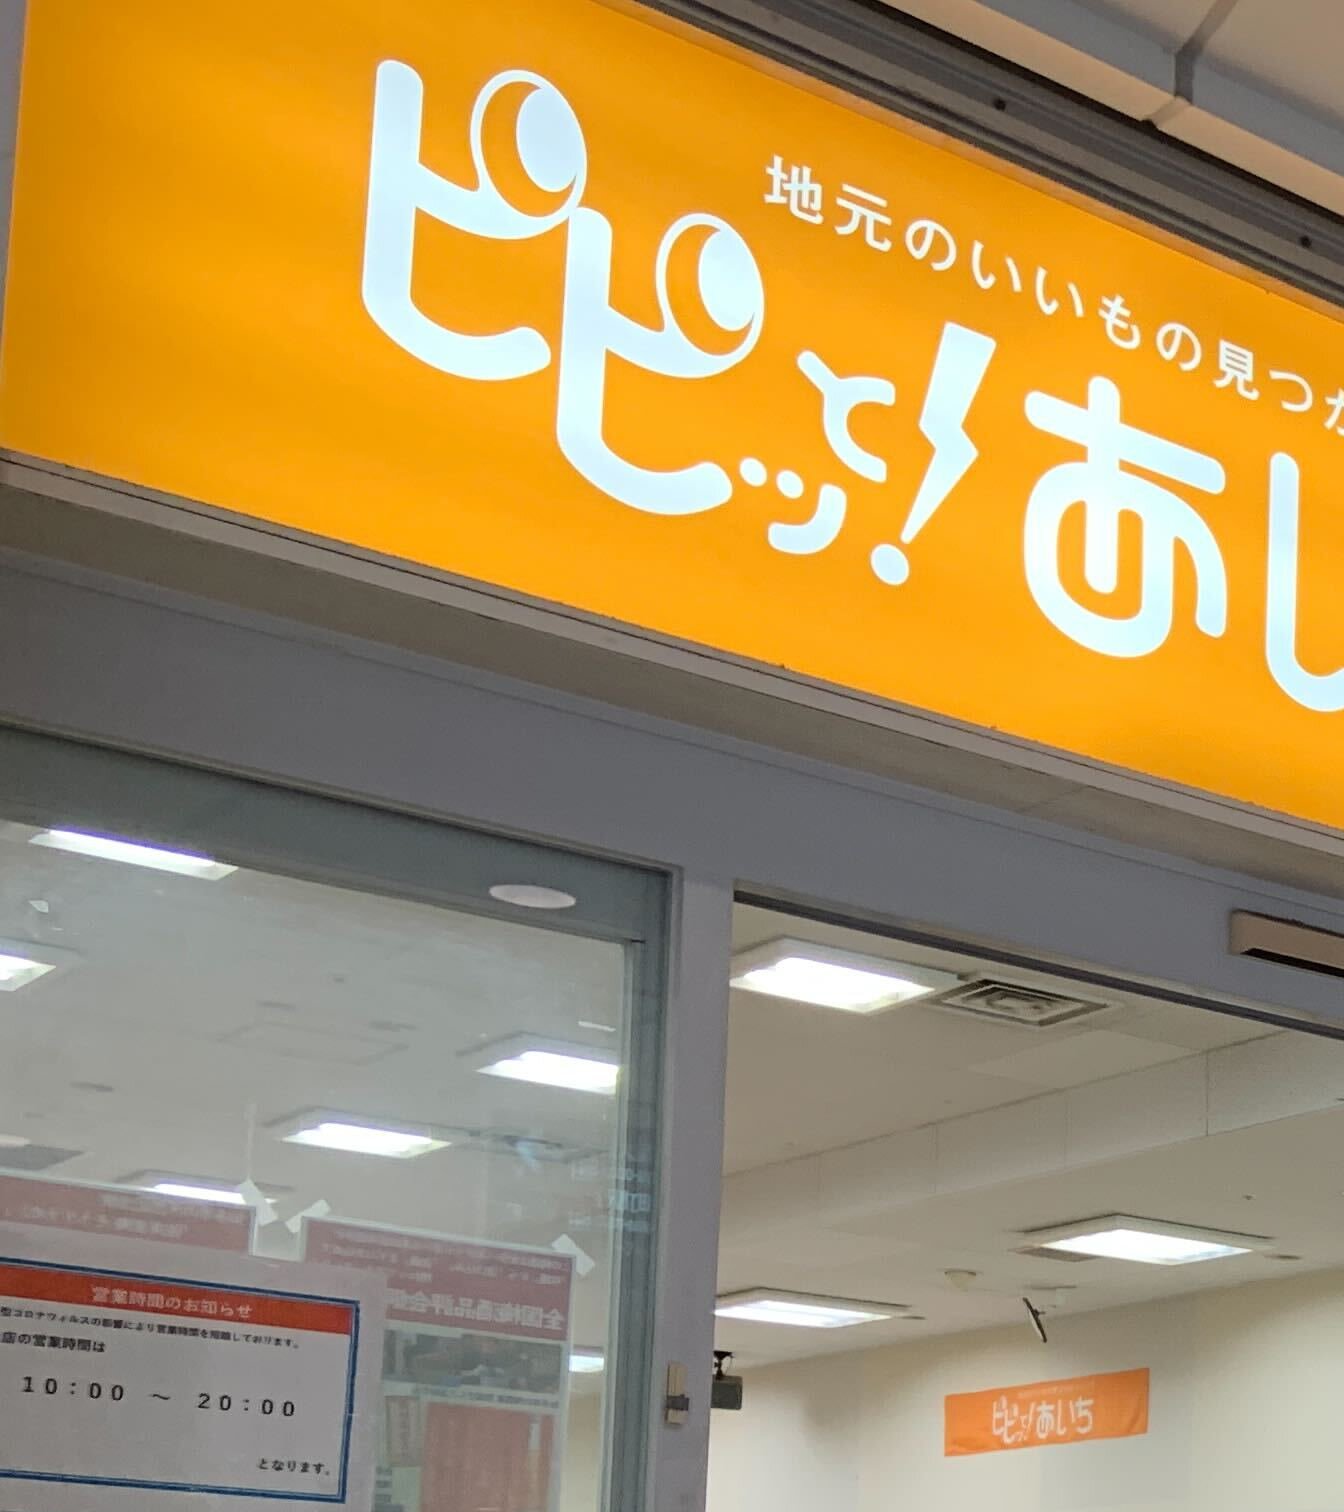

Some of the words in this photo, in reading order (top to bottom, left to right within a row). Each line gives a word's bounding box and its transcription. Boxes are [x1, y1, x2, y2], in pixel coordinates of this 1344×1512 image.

[90, 1285, 254, 1319] 営業時間のお知らせ
[257, 1456, 331, 1477] となります。
